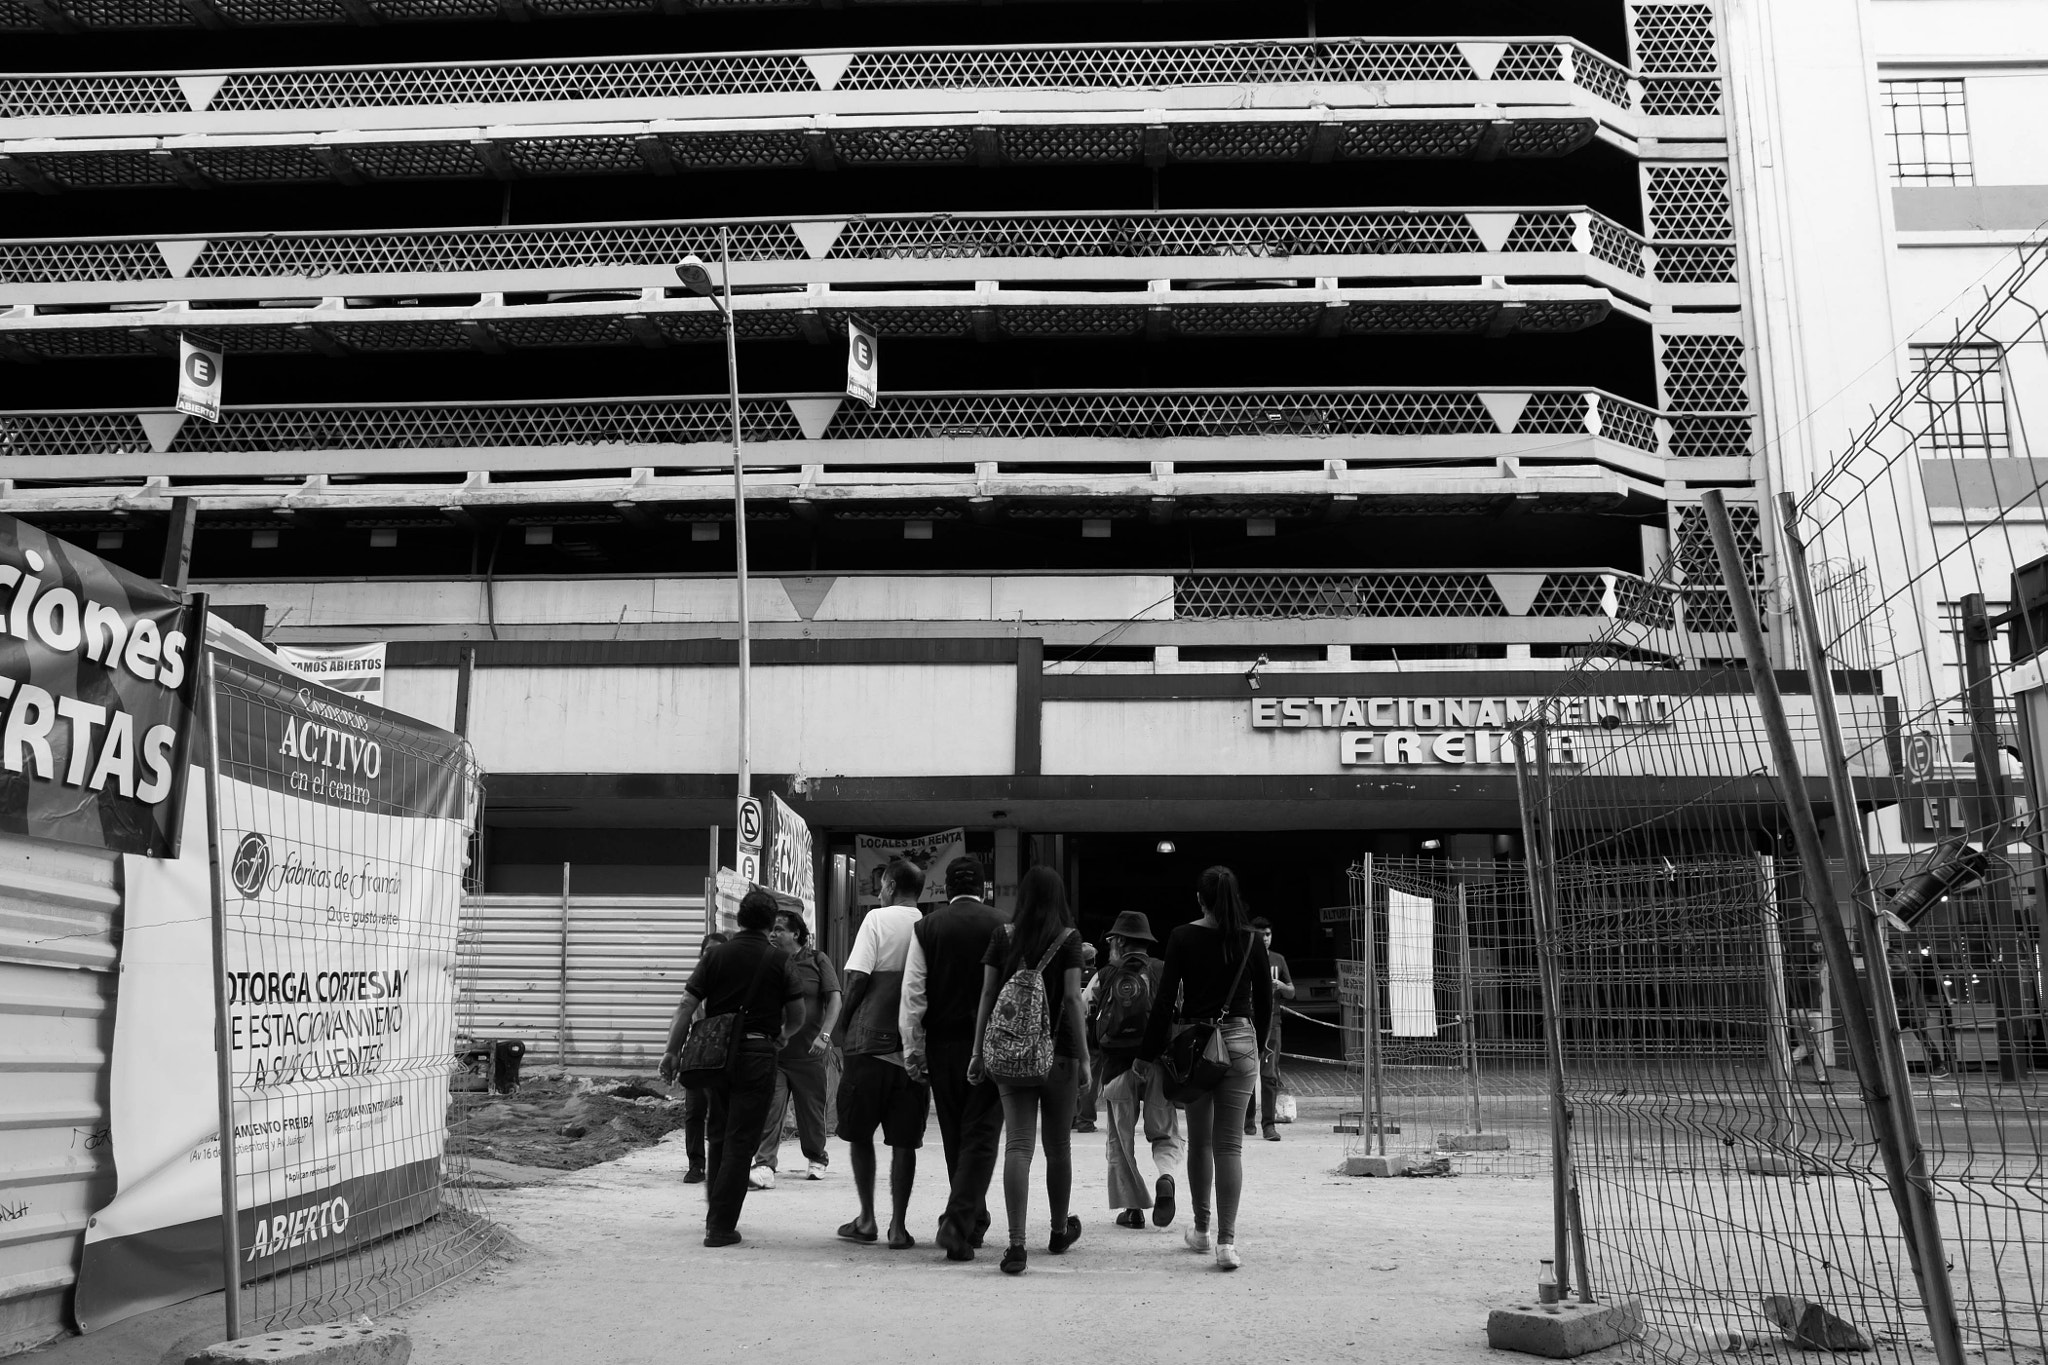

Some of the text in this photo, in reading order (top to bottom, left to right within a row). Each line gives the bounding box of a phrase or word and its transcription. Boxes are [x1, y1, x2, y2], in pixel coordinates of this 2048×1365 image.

[858, 341, 868, 365] E
[194, 358, 209, 381] E
[178, 400, 216, 419] ABIERTO
[329, 658, 382, 672] ABIERTOS
[1252, 695, 1671, 729] ESTACIONAMIENTO
[279, 715, 381, 779] ACTIVO
[290, 768, 370, 805] en el centro
[860, 831, 962, 849] LOCALES EN RENTA
[334, 865, 348, 890] de
[328, 905, 350, 922] Qué
[353, 910, 377, 927] gusto
[253, 1058, 266, 1093] A
[283, 1115, 314, 1131] FREIBA
[203, 1147, 212, 1160] 16
[247, 1196, 350, 1262] ABIERTO
